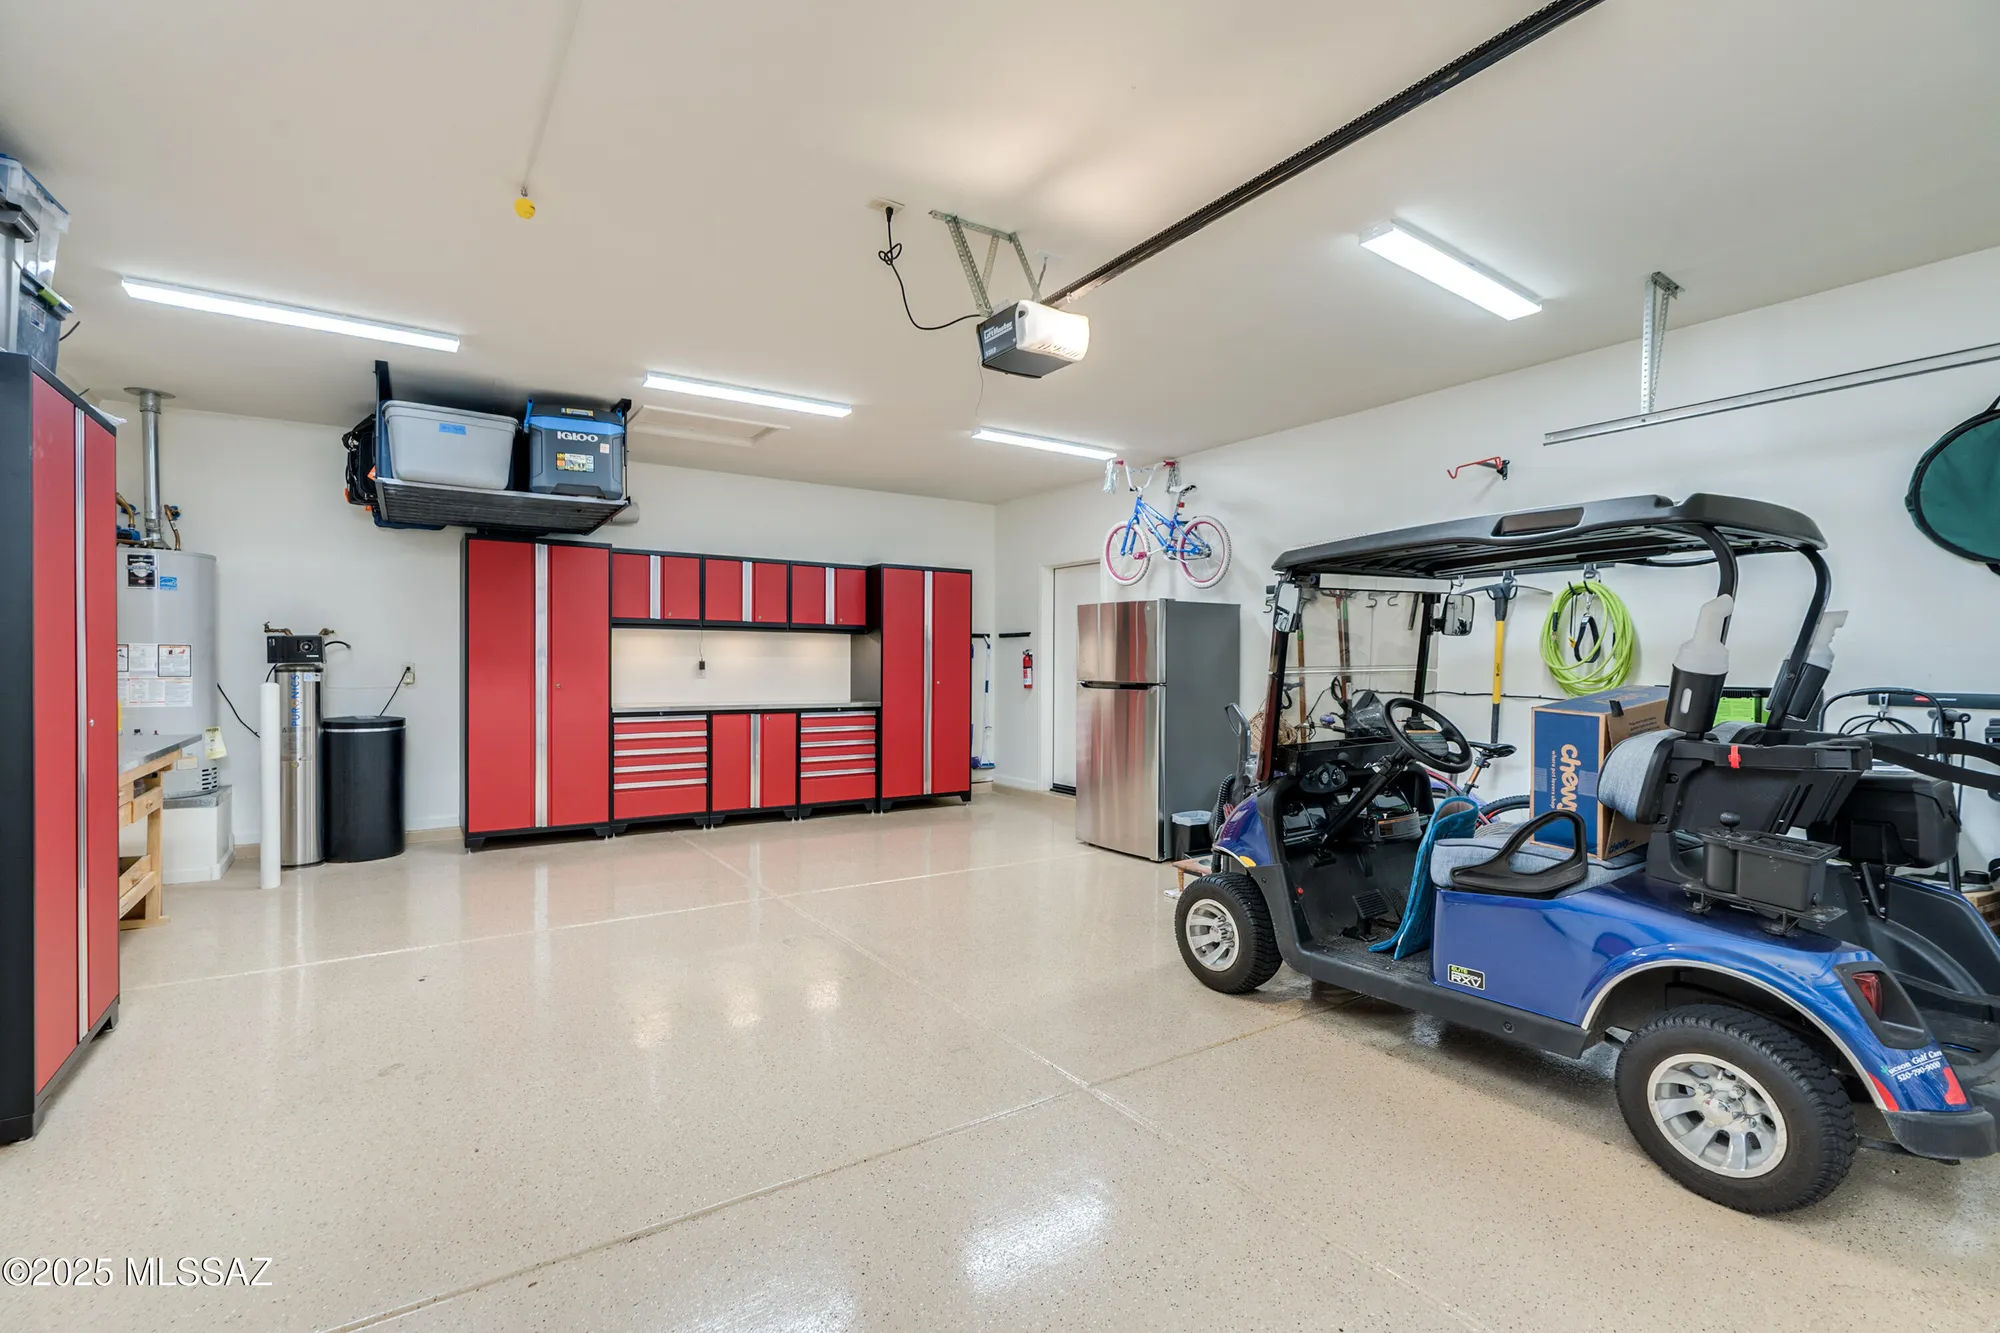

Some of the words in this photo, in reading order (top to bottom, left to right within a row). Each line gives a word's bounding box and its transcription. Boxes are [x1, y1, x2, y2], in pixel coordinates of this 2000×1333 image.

[557, 431, 598, 443] IGLOO
[290, 674, 300, 727] PURONICS
[1557, 744, 1581, 812] chewy
[1451, 974, 1482, 987] RXV
[1912, 1053, 1928, 1065] Golf
[1897, 1061, 1941, 1082] 520-790-9000
